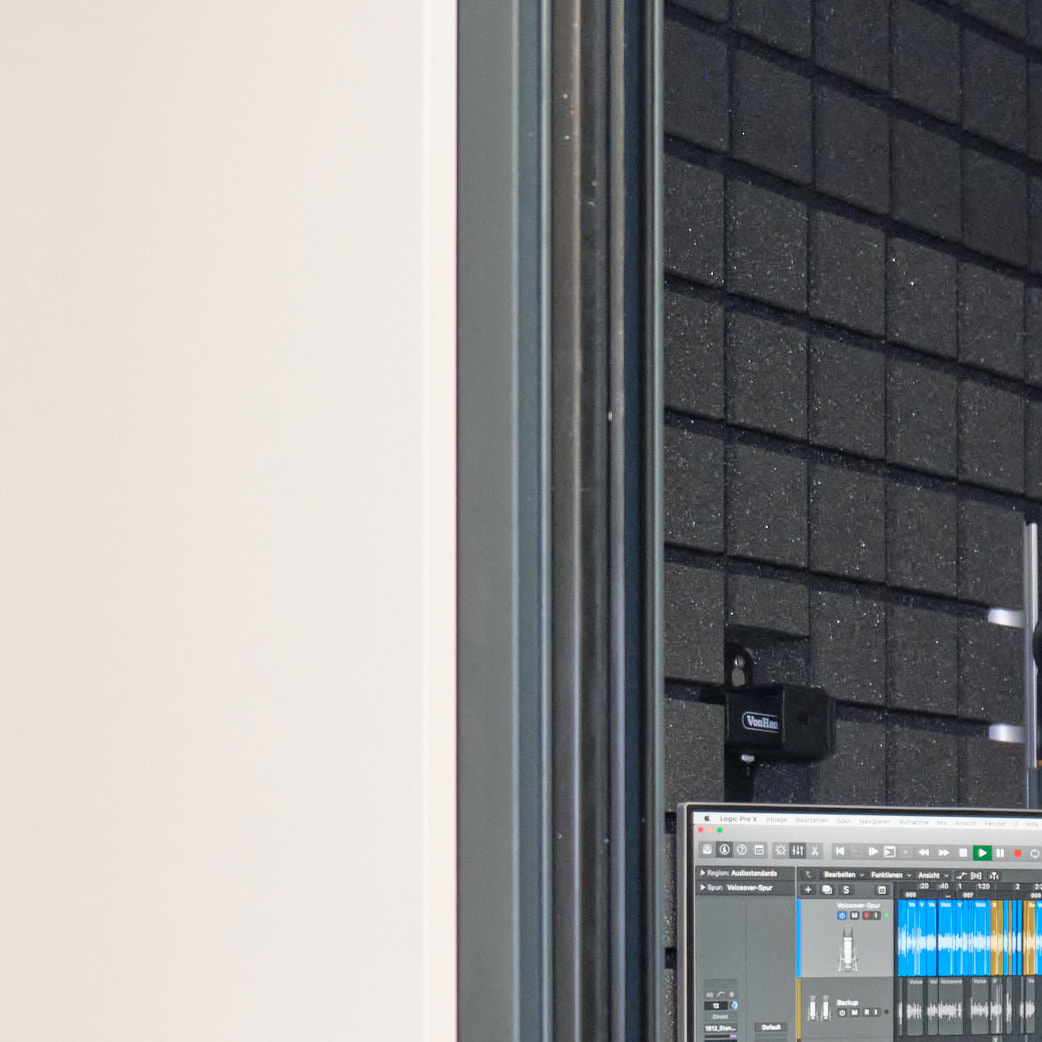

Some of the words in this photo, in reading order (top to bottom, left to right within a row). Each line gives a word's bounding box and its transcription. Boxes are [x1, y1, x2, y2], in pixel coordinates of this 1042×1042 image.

[746, 715, 778, 729] VonHau
[720, 815, 737, 823] Logic
[707, 885, 723, 893] Spur:
[727, 885, 773, 893] Voiceover-Spur
[837, 902, 881, 910] Voiceover-Spur
[837, 1000, 859, 1008] Backup
